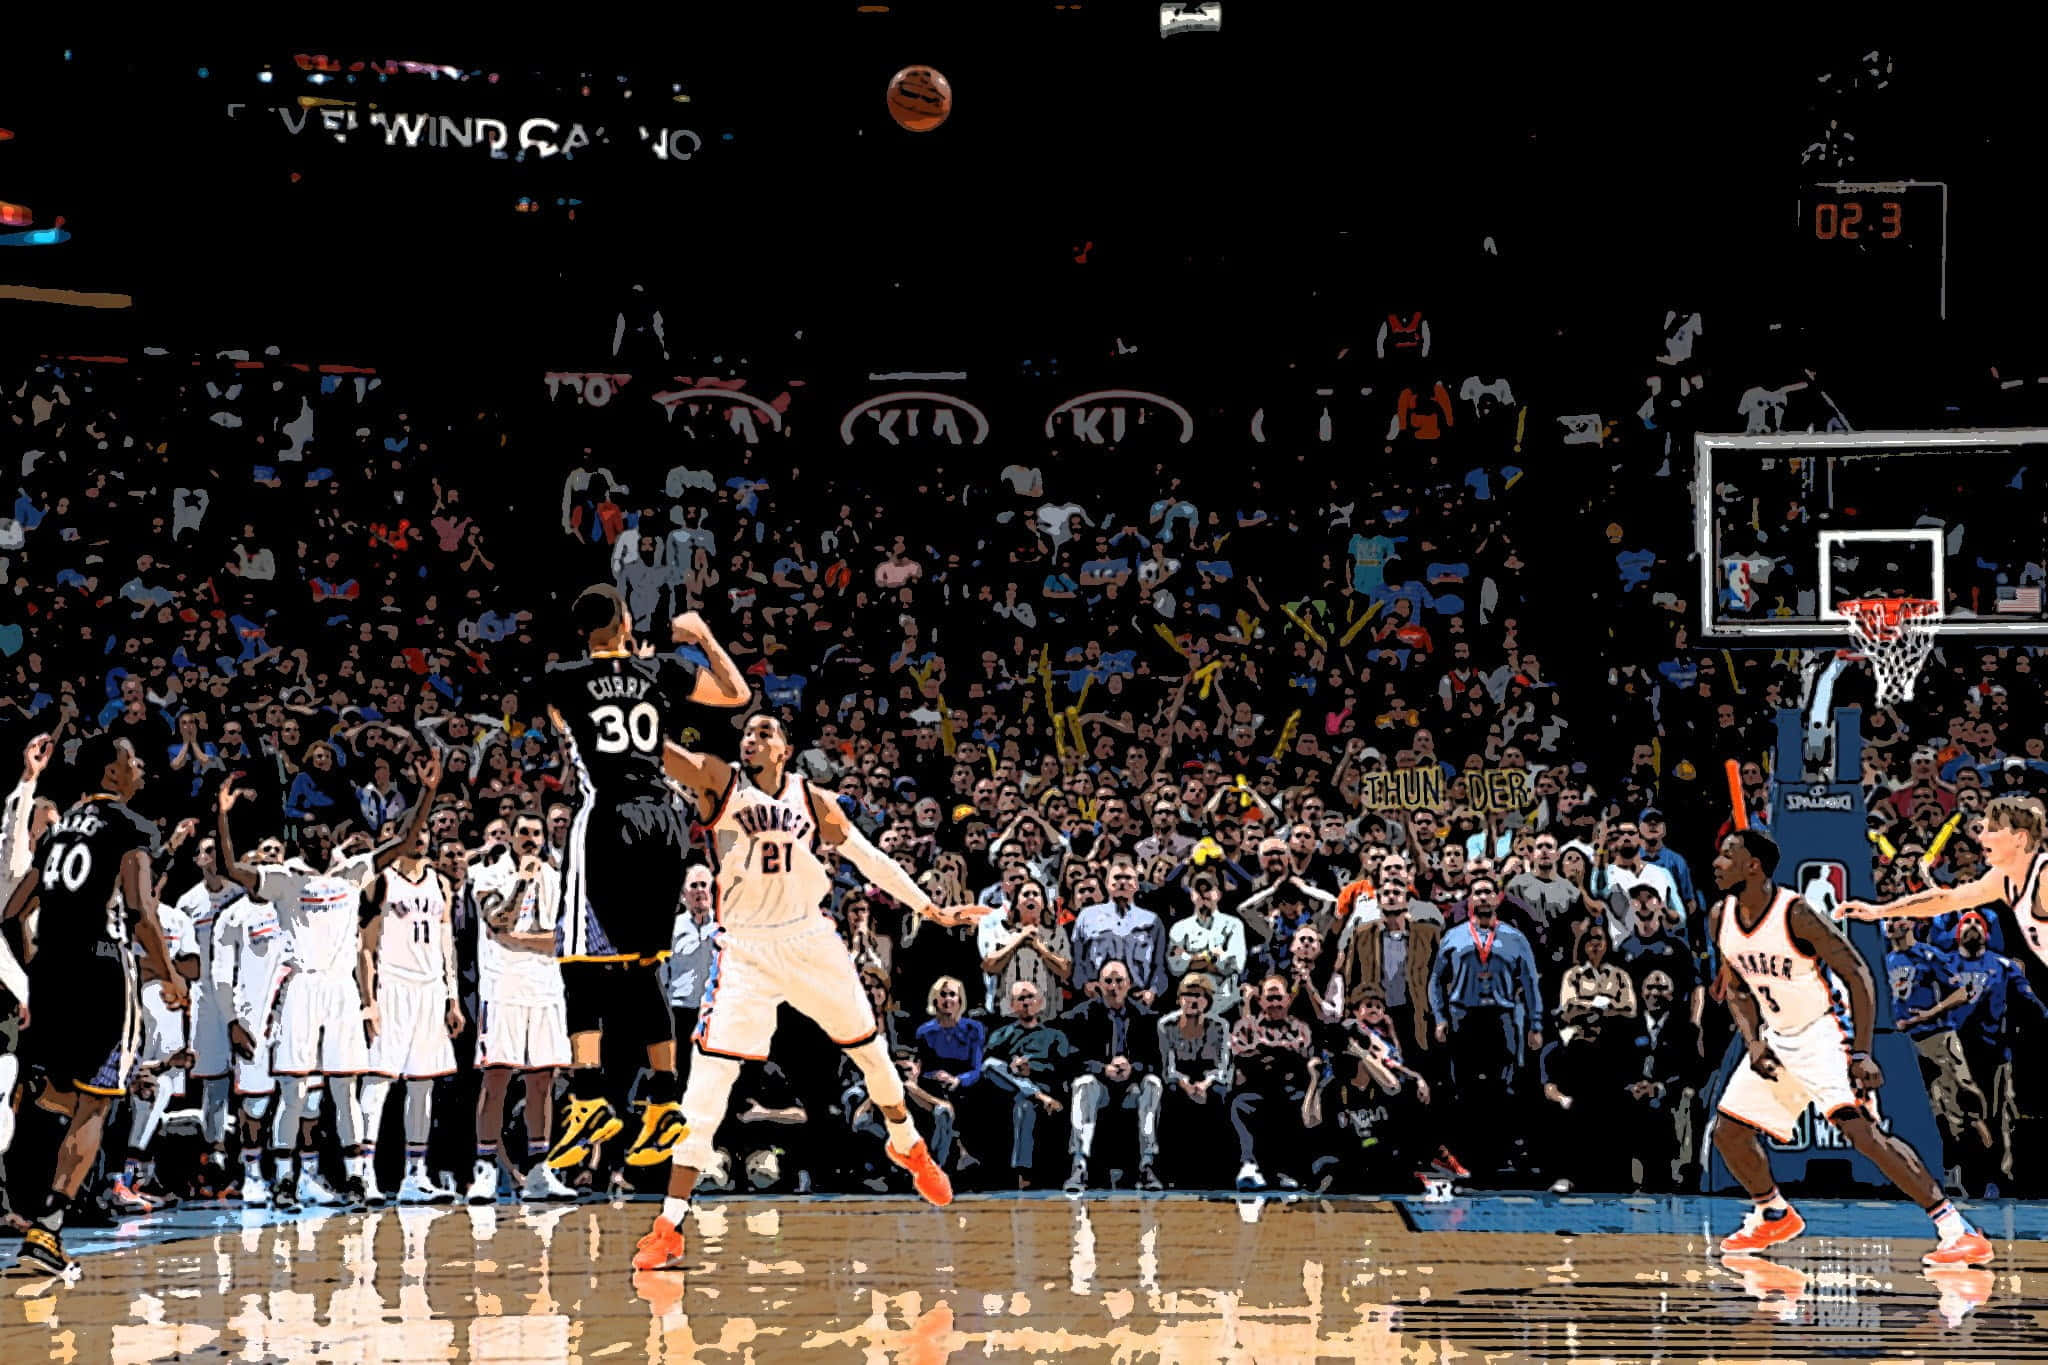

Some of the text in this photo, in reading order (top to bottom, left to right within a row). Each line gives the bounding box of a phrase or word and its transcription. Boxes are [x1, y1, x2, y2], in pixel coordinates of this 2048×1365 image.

[587, 676, 651, 700] CURRY
[588, 702, 659, 753] 30
[1366, 769, 1529, 812] THUN DER
[43, 843, 92, 892] 40
[761, 842, 793, 874] 21
